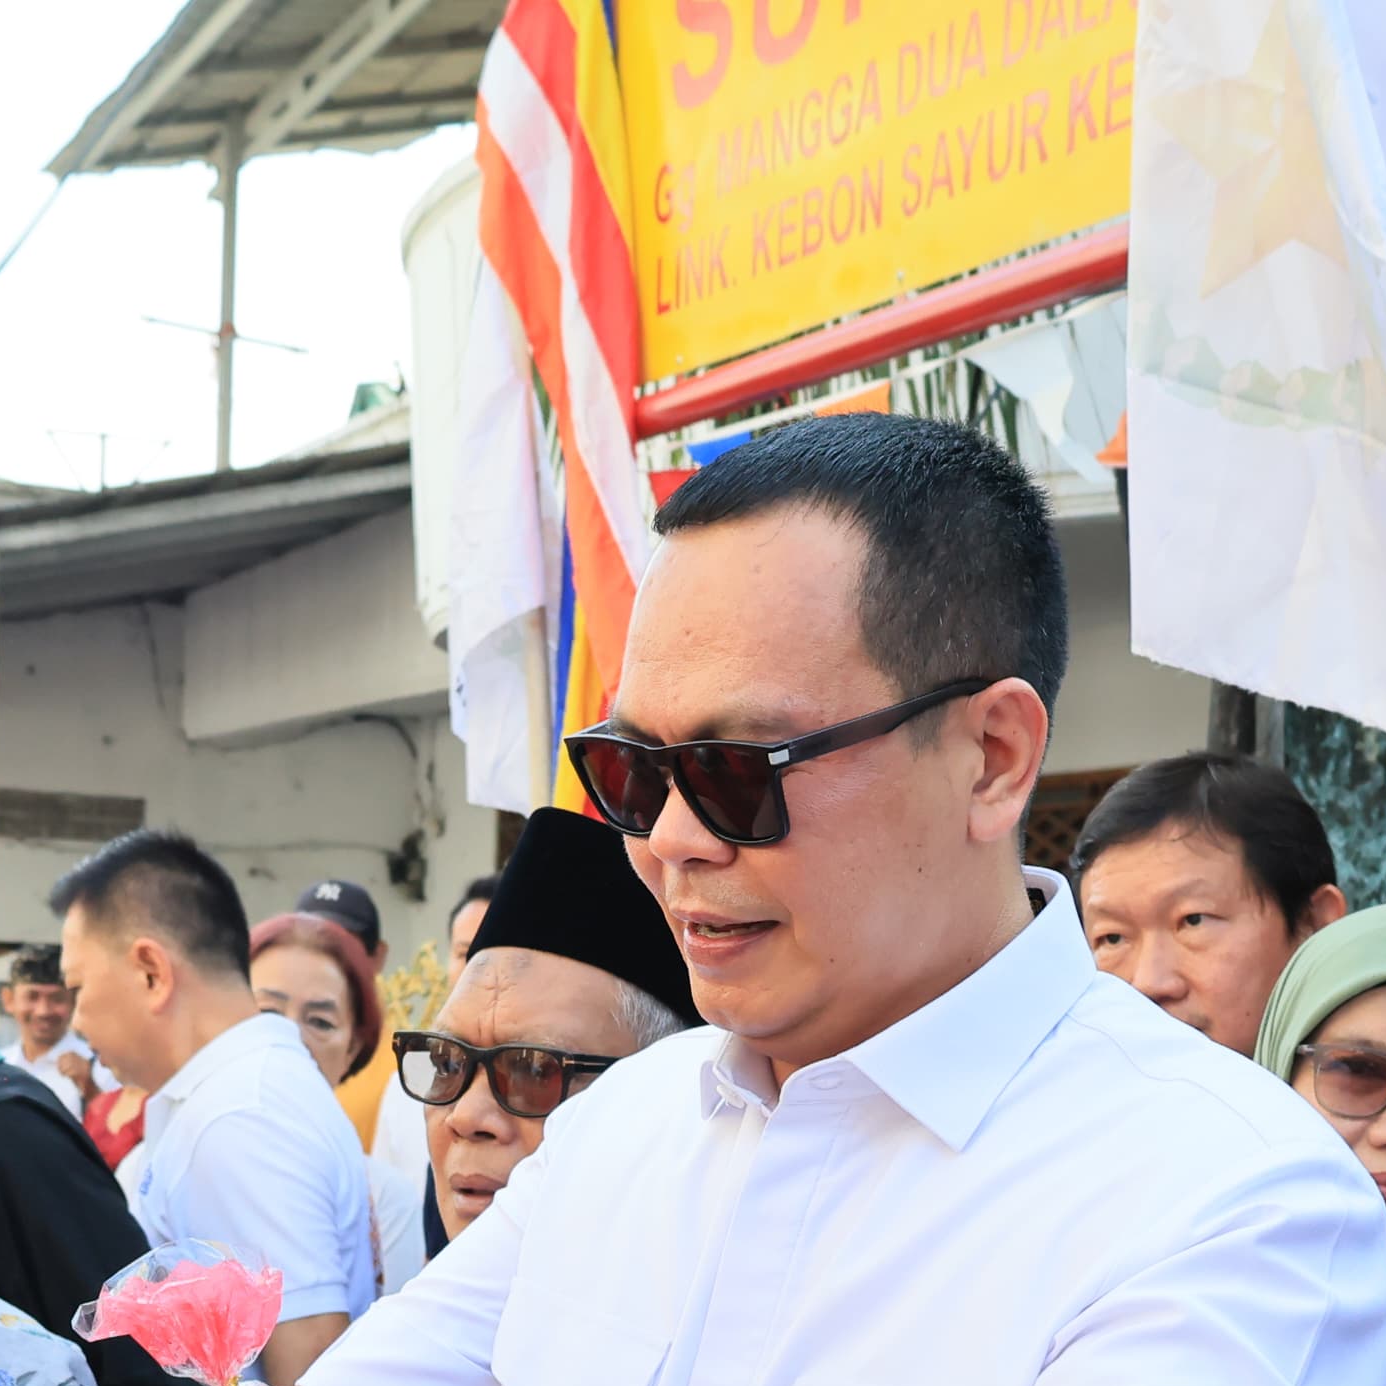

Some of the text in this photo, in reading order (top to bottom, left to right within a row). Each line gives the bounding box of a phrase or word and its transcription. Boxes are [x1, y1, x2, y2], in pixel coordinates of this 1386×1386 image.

[716, 59, 883, 199] MANGGA
[896, 9, 988, 118] DUA
[751, 157, 884, 278] KEBON
[901, 88, 1049, 219] SAYUR
